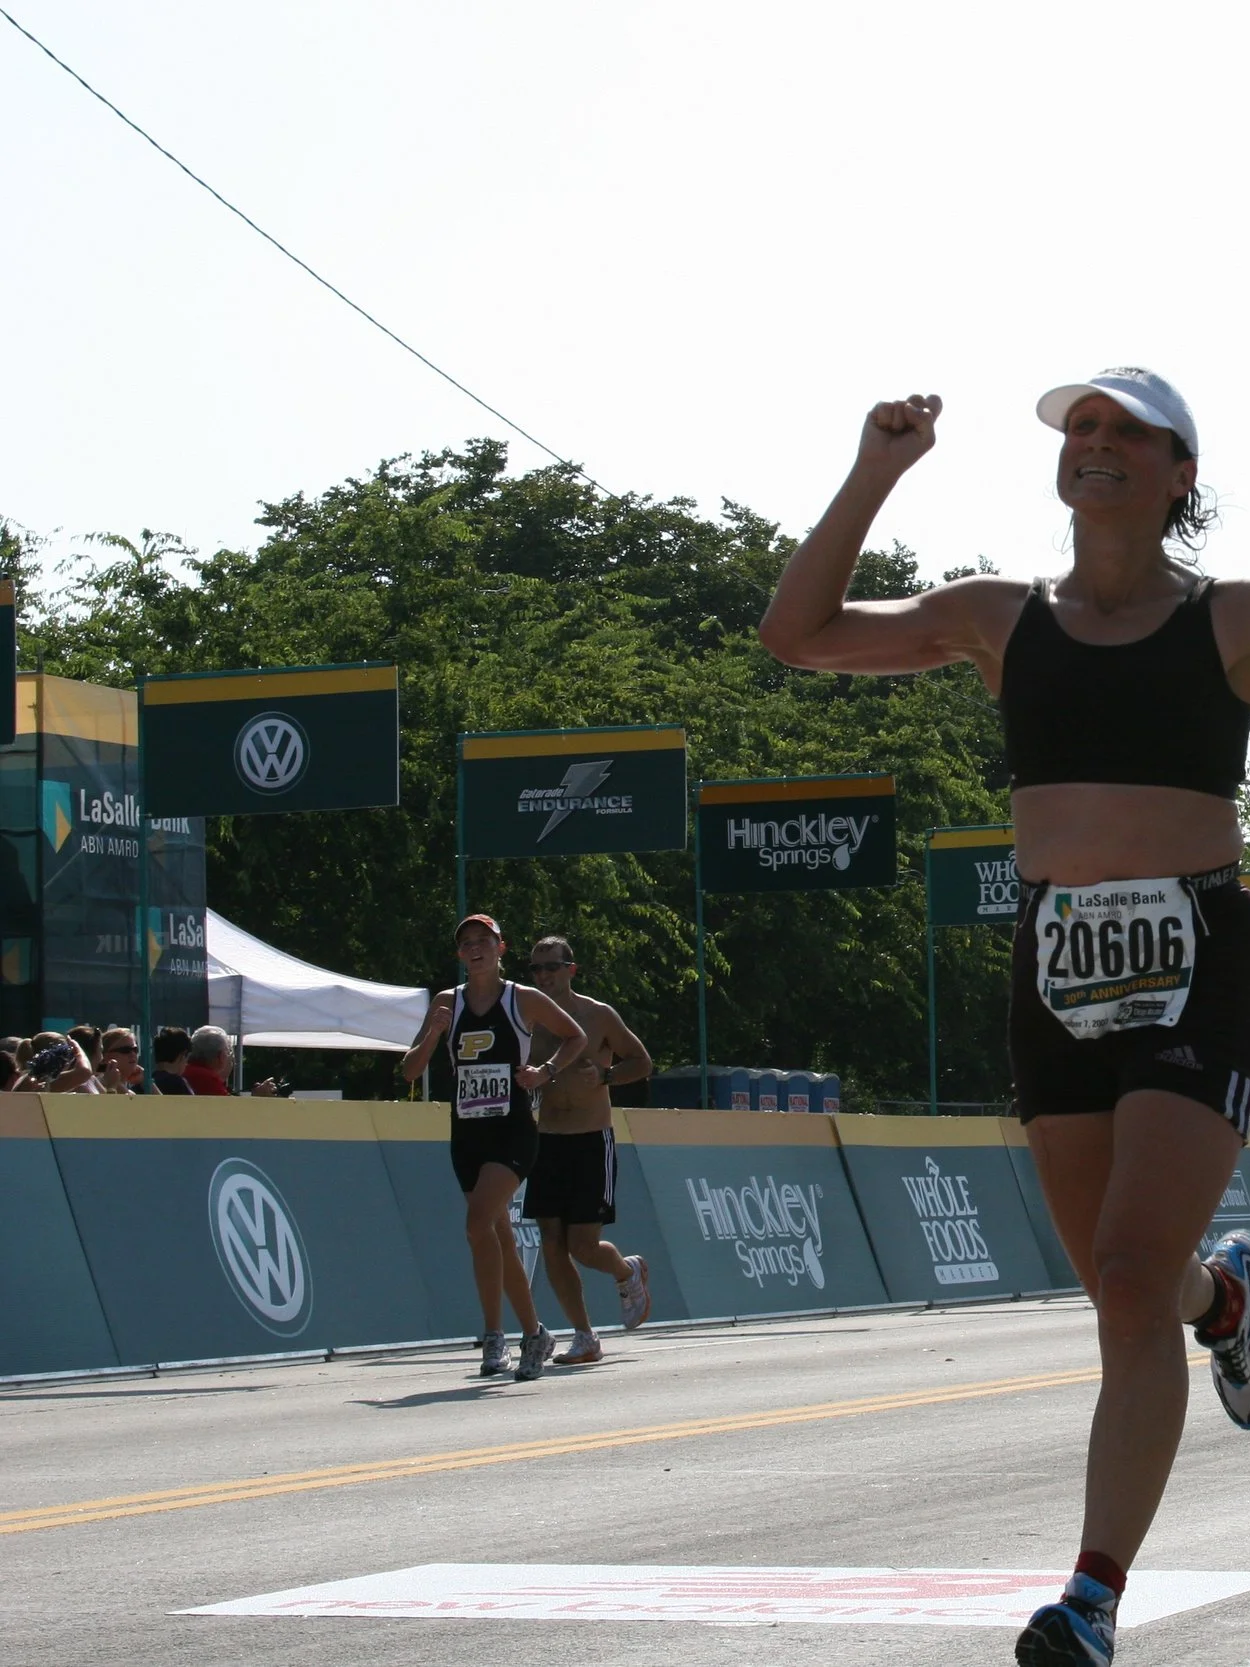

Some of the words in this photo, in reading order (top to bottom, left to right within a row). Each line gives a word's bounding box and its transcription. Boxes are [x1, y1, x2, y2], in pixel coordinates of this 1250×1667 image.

[518, 796, 633, 812] ENDURANCE
[519, 788, 563, 799] Gatorade
[595, 807, 633, 815] FORMULA
[727, 813, 868, 854] Hinckley
[80, 835, 103, 854] ABN
[108, 837, 139, 858] AMRO
[758, 847, 831, 871] Springs
[974, 860, 1019, 883] WHO
[979, 882, 1019, 904] FOO
[1078, 893, 1128, 907] LaSalle
[1132, 890, 1166, 905] Bank
[1078, 911, 1095, 920] ABN
[1044, 916, 1184, 979] 20606
[1063, 990, 1087, 1005] 30th
[1090, 974, 1182, 1001] ANNIVERSARY
[458, 1030, 495, 1060] P
[459, 1080, 466, 1099] B
[470, 1078, 509, 1099] 3403
[901, 1175, 979, 1218] WHOLE
[685, 1175, 824, 1257] Hinckley
[919, 1219, 989, 1262] FOODS
[735, 1240, 806, 1289] Springs
